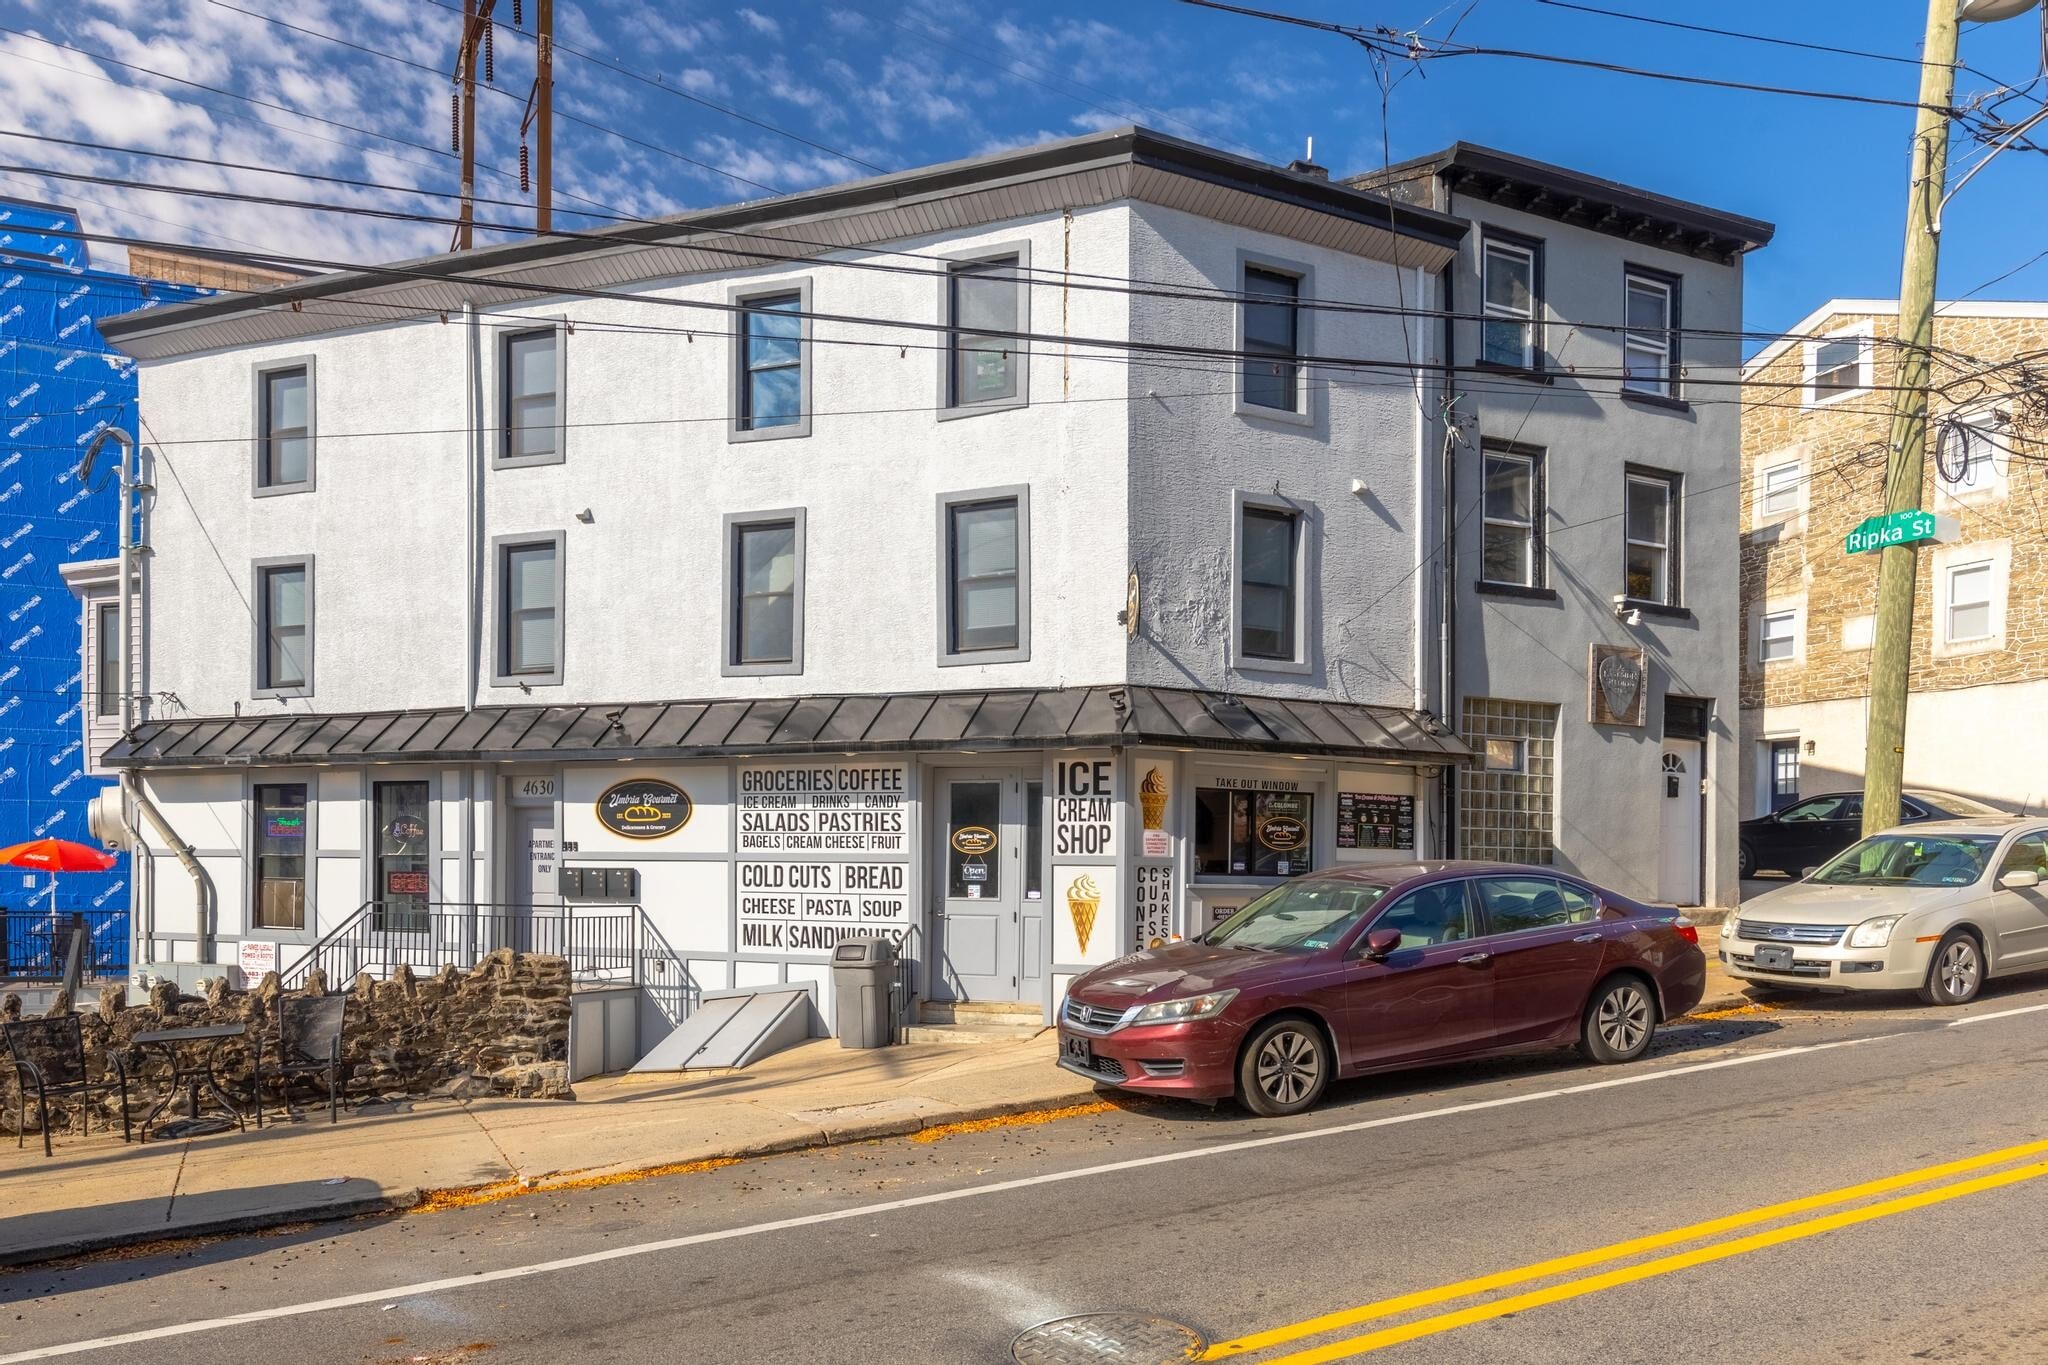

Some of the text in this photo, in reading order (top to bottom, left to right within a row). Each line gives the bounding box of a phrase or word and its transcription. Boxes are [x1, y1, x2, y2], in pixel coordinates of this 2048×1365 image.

[1900, 512, 1913, 520] 100
[1850, 519, 1932, 550] Ripka St
[742, 769, 902, 792] GROCERIES COFFEE
[1058, 761, 1112, 796] ICE
[1216, 778, 1299, 791] TAKE OUT WINDOW
[523, 780, 554, 795] 4630
[609, 793, 679, 808] Umbria Gourmet
[743, 795, 900, 809] ICE CREAM DRINKS CANDY
[1057, 798, 1112, 822] CREAM
[742, 812, 902, 831] SALADS PASTRIES
[401, 824, 424, 838] Coffee
[1057, 824, 1112, 854] SHOP
[528, 840, 554, 848] APARTME
[743, 835, 902, 849] BAGELS CREAM CHEESE FRUIT
[530, 852, 555, 861] ENTRANC
[538, 864, 552, 873] ONLY
[742, 865, 903, 889] COLD CUTS BREAD
[964, 866, 985, 877] Open
[742, 897, 902, 917] CHEESE PASTA SOUP
[1148, 867, 1158, 936] CUPS
[1161, 867, 1170, 938] SHAKES
[743, 924, 783, 948] MILK
